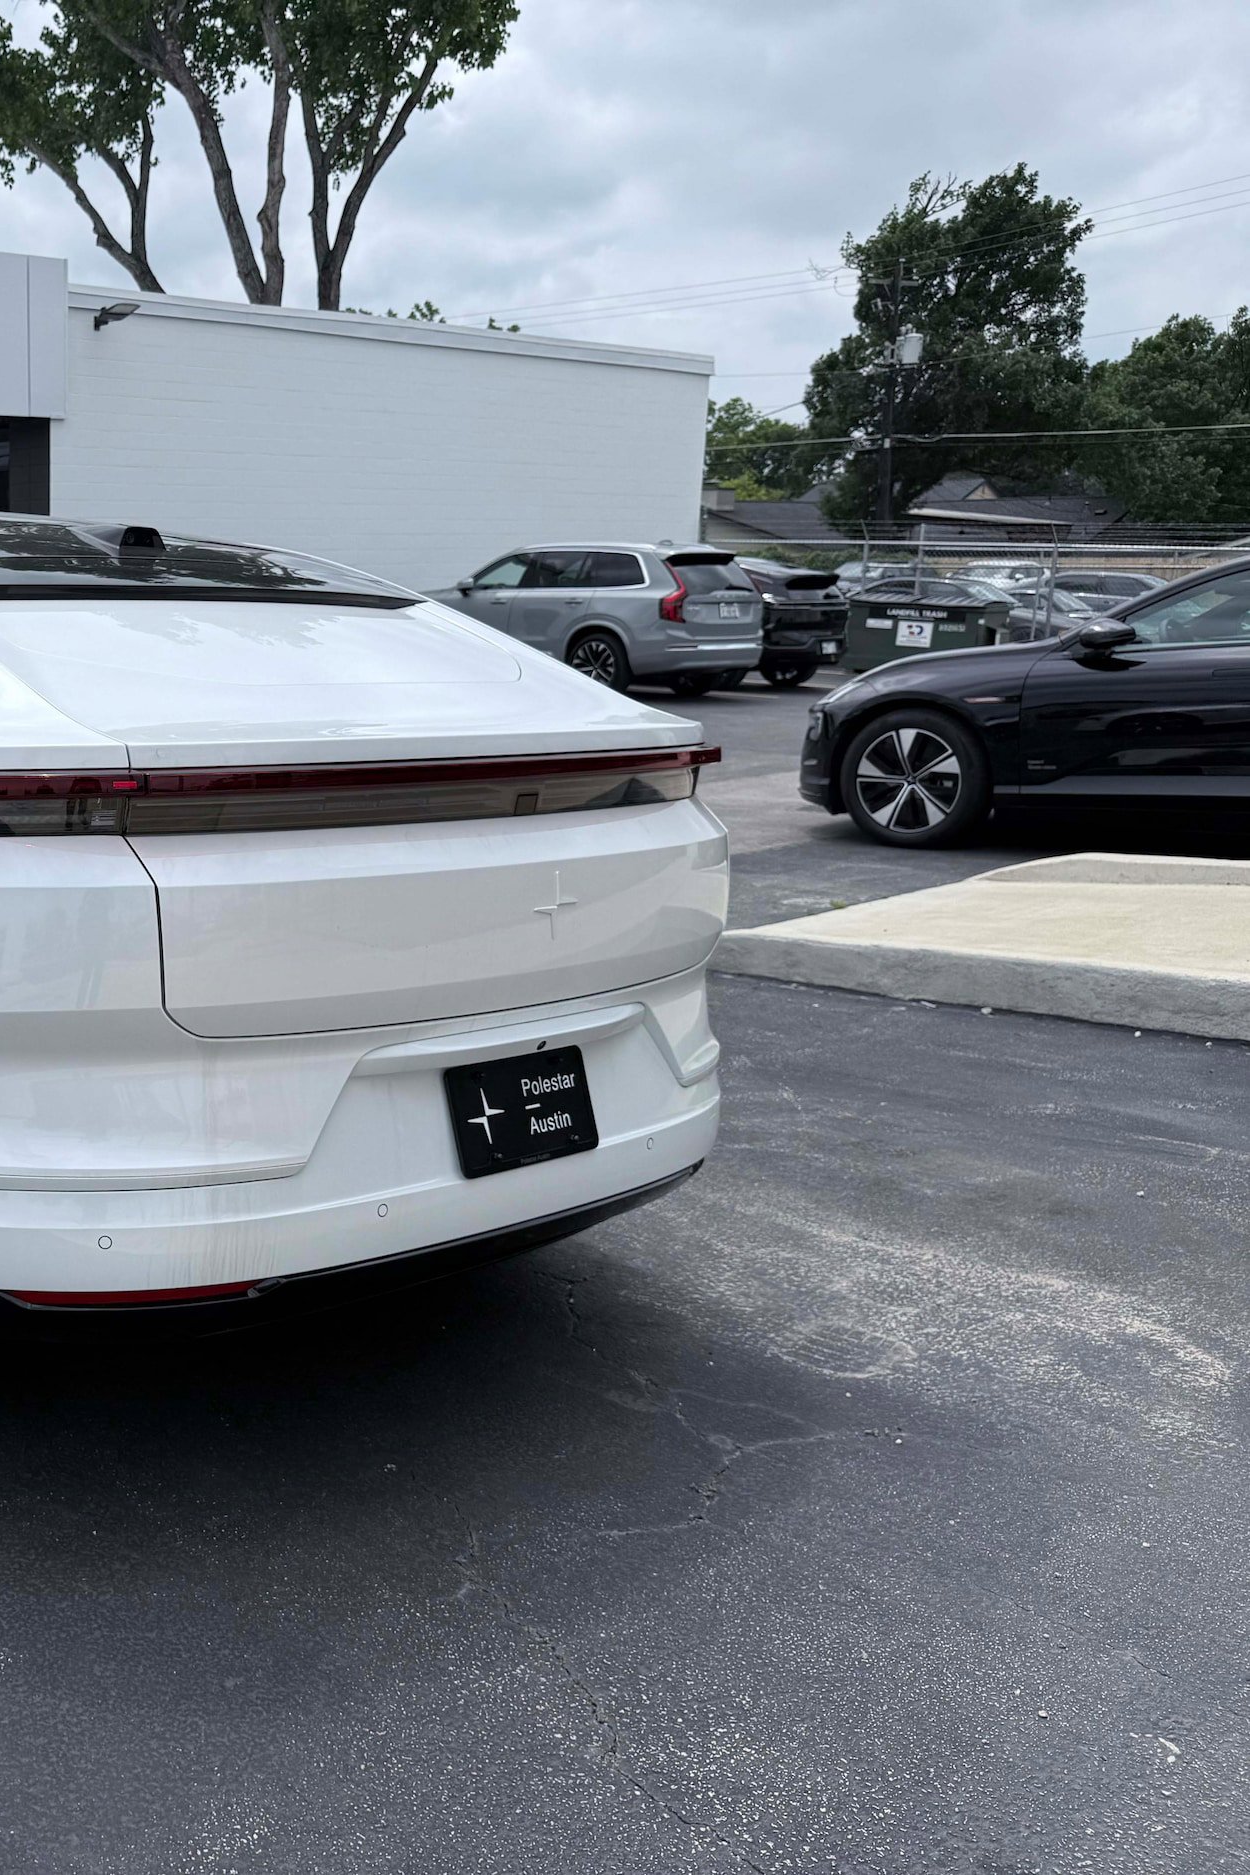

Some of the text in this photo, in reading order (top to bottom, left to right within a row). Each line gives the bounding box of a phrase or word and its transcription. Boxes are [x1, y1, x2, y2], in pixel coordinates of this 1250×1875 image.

[886, 608, 948, 619] LANDFILL TRASH
[520, 1073, 576, 1097] Polestar
[530, 1110, 572, 1135] Austin
